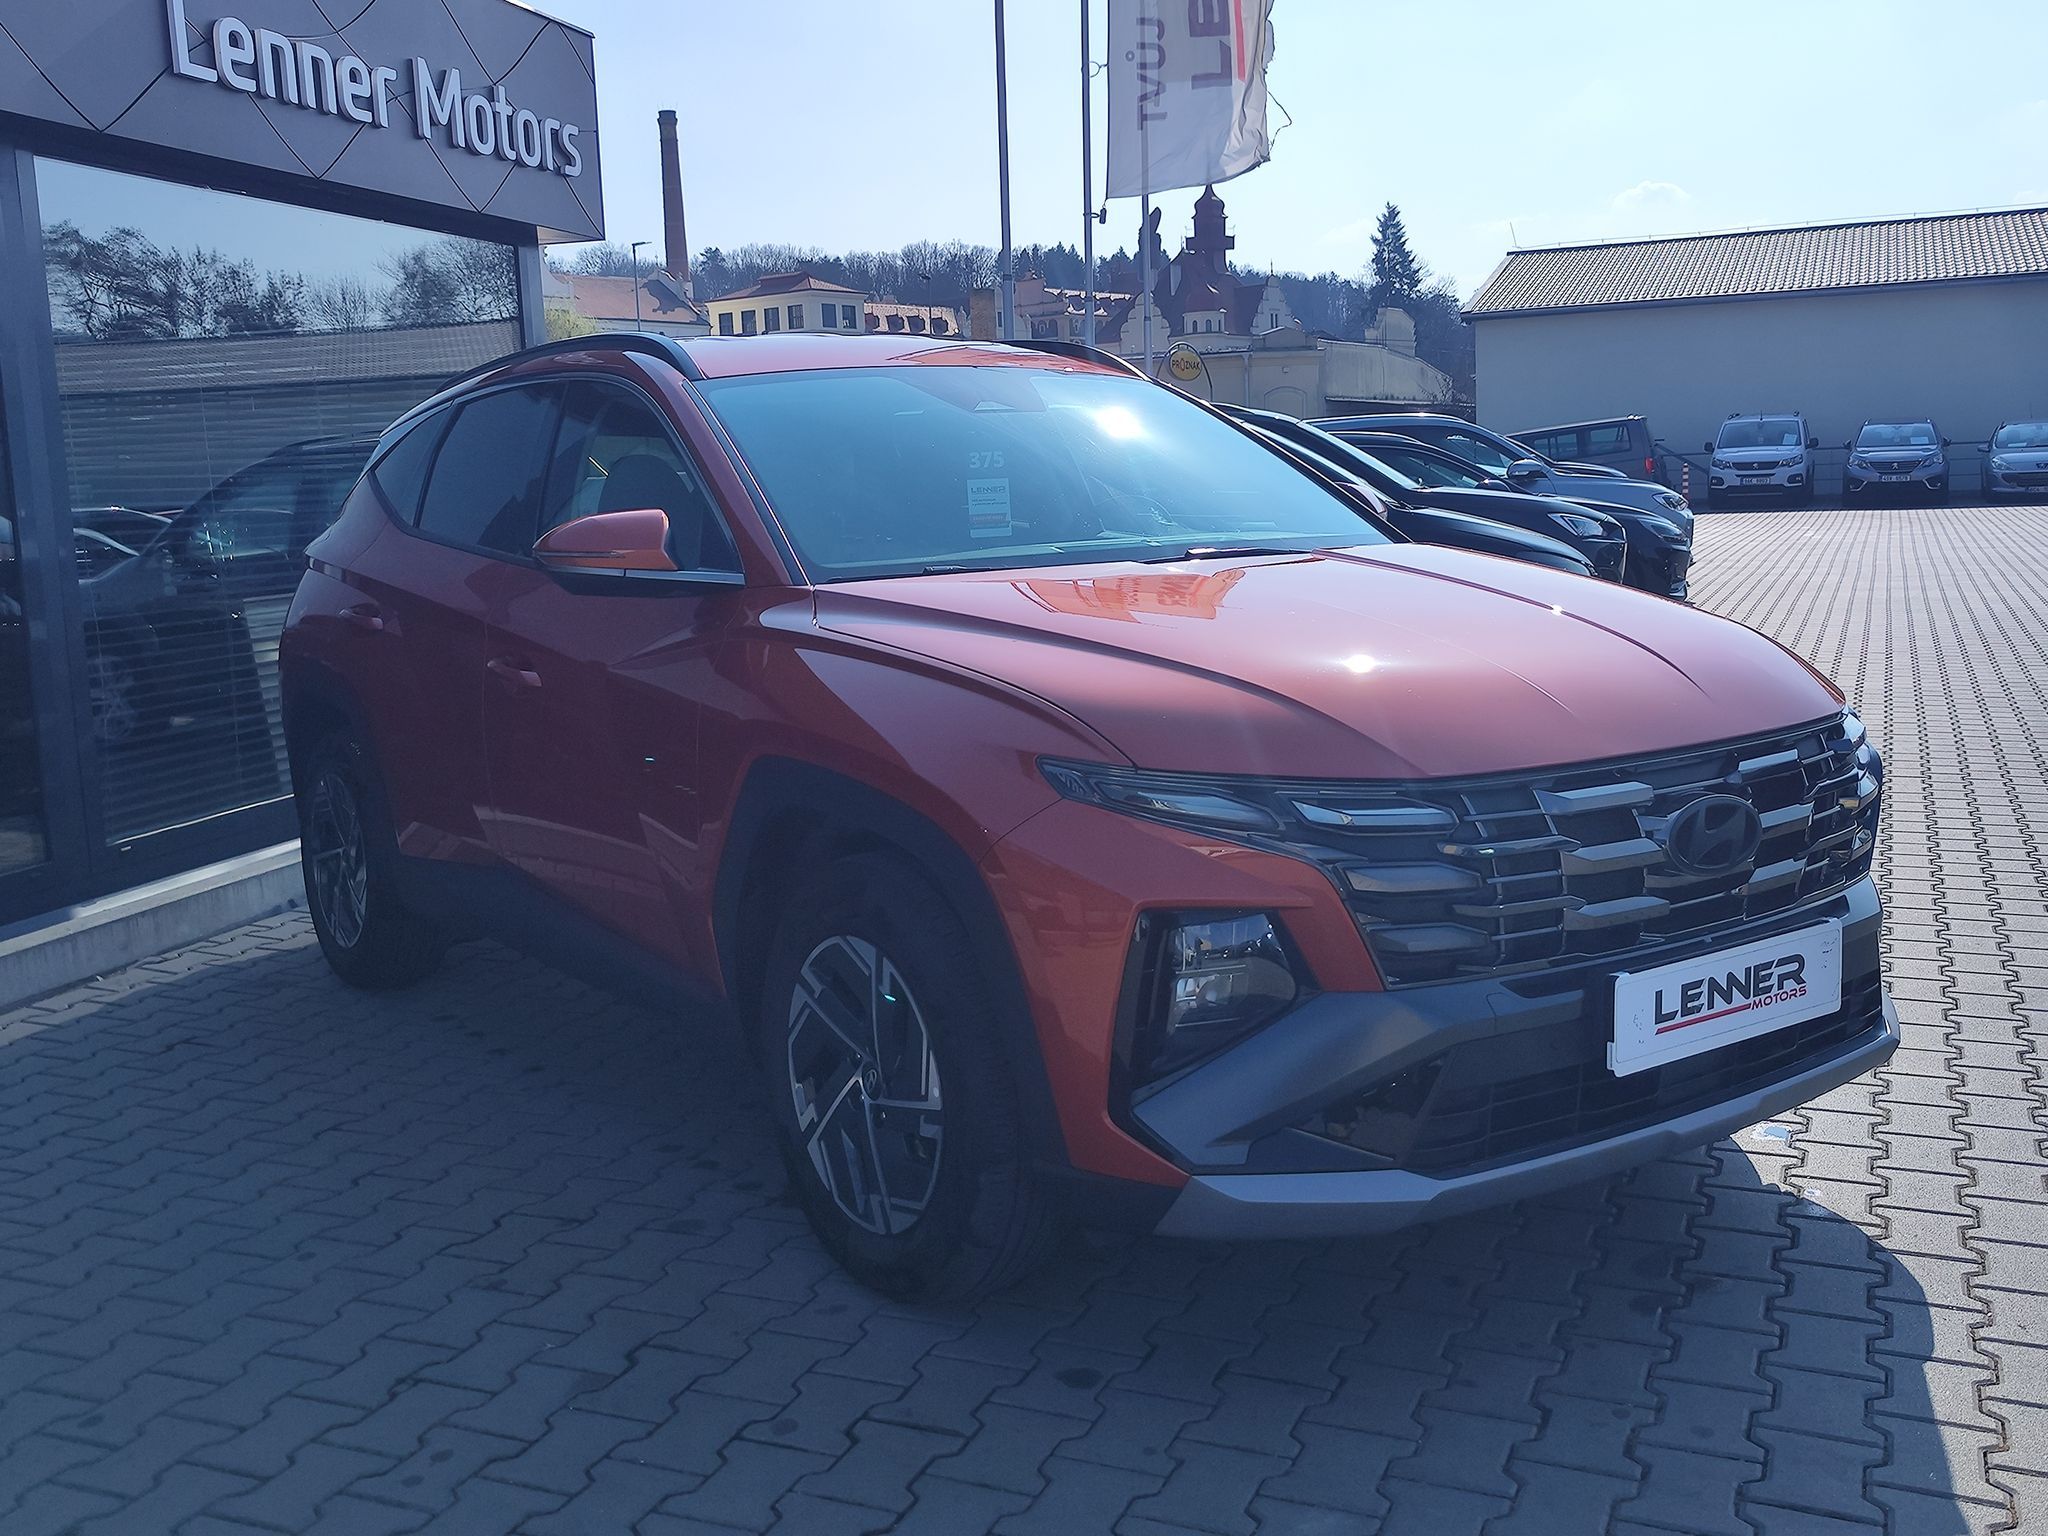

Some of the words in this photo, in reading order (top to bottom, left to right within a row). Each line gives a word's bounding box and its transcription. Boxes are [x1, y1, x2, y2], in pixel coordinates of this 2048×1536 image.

[166, 0, 398, 129] Lenner
[412, 56, 583, 178] Motors
[1125, 17, 1168, 131] TVŮJ
[968, 451, 1005, 469] 375
[1654, 953, 1808, 1025] LENNER
[1751, 985, 1808, 1011] MOTORS
